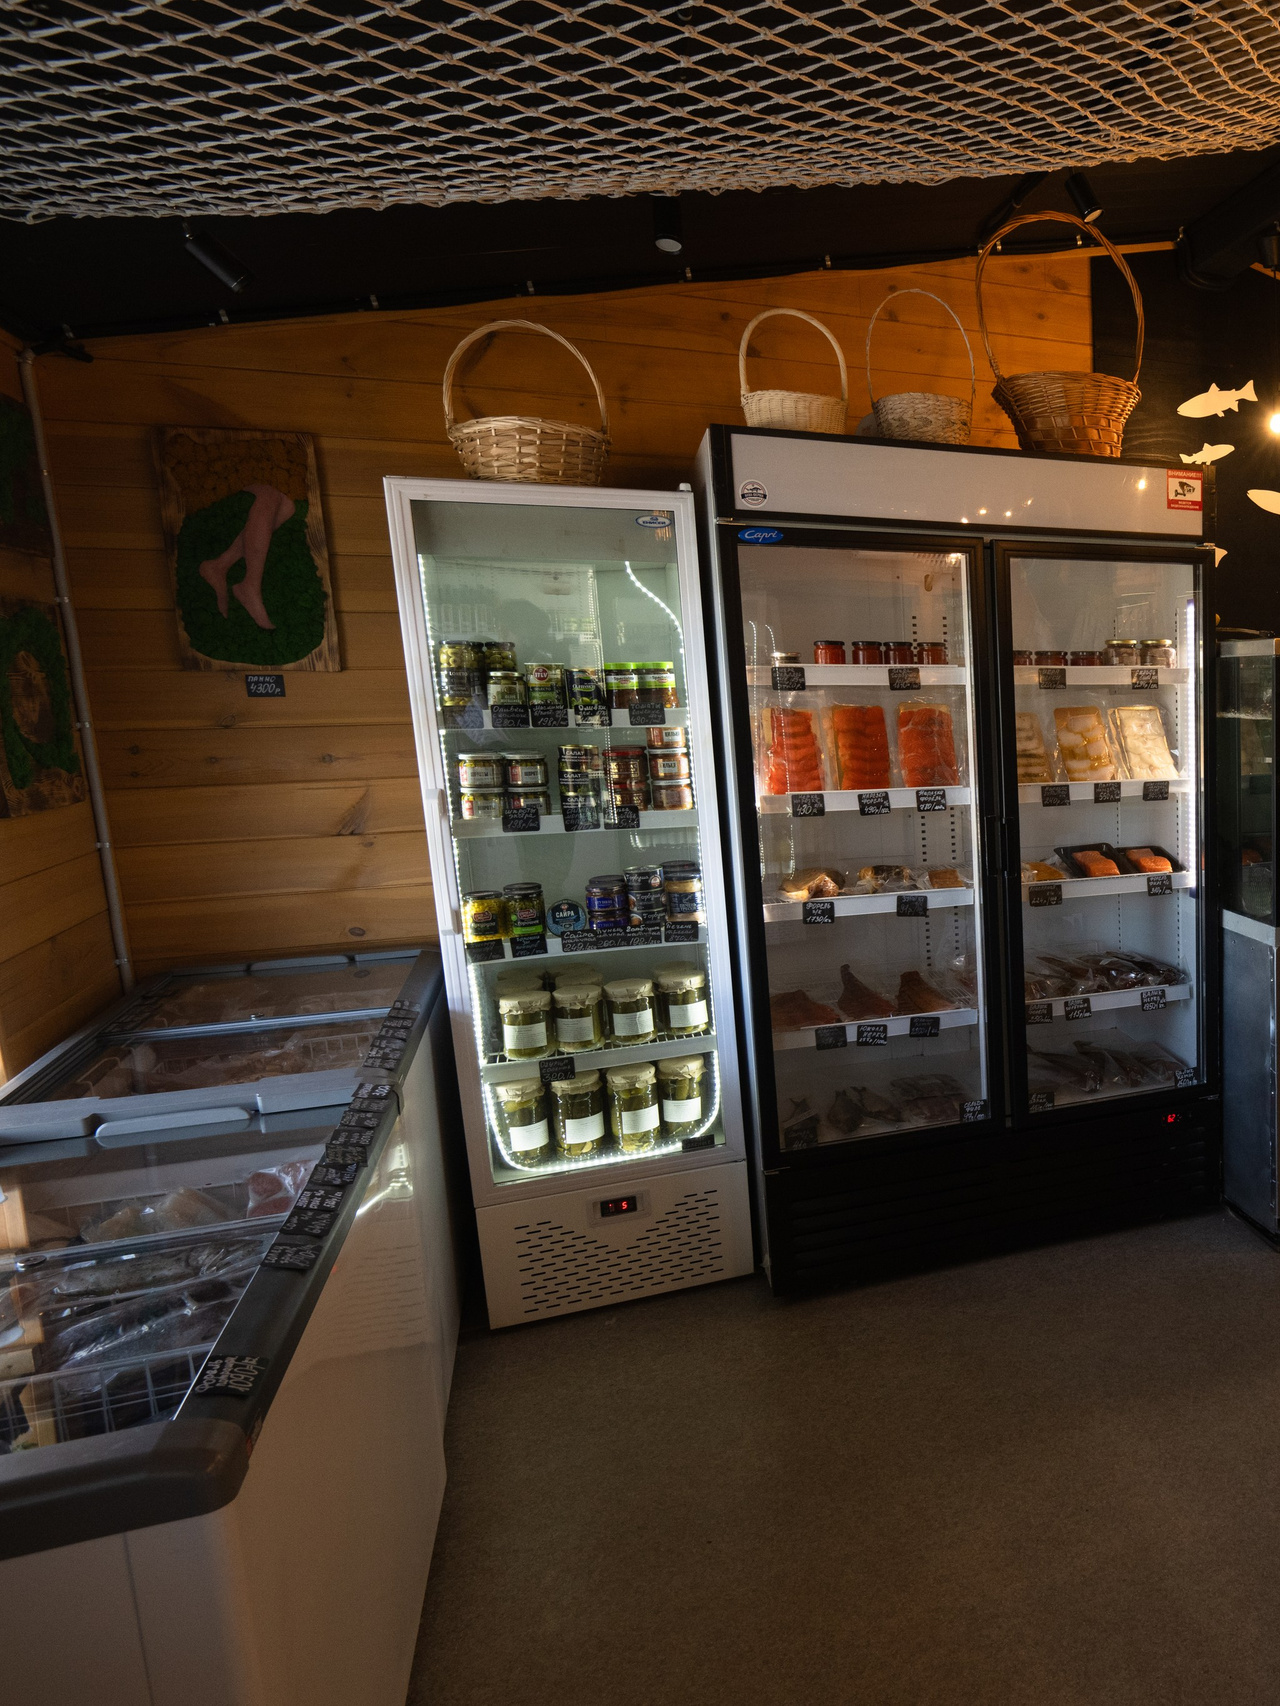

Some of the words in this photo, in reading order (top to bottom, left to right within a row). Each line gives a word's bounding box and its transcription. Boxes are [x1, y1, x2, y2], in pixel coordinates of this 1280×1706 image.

[744, 530, 778, 542] Capri
[247, 675, 276, 683] ПАННО
[555, 910, 575, 919] САЙРА
